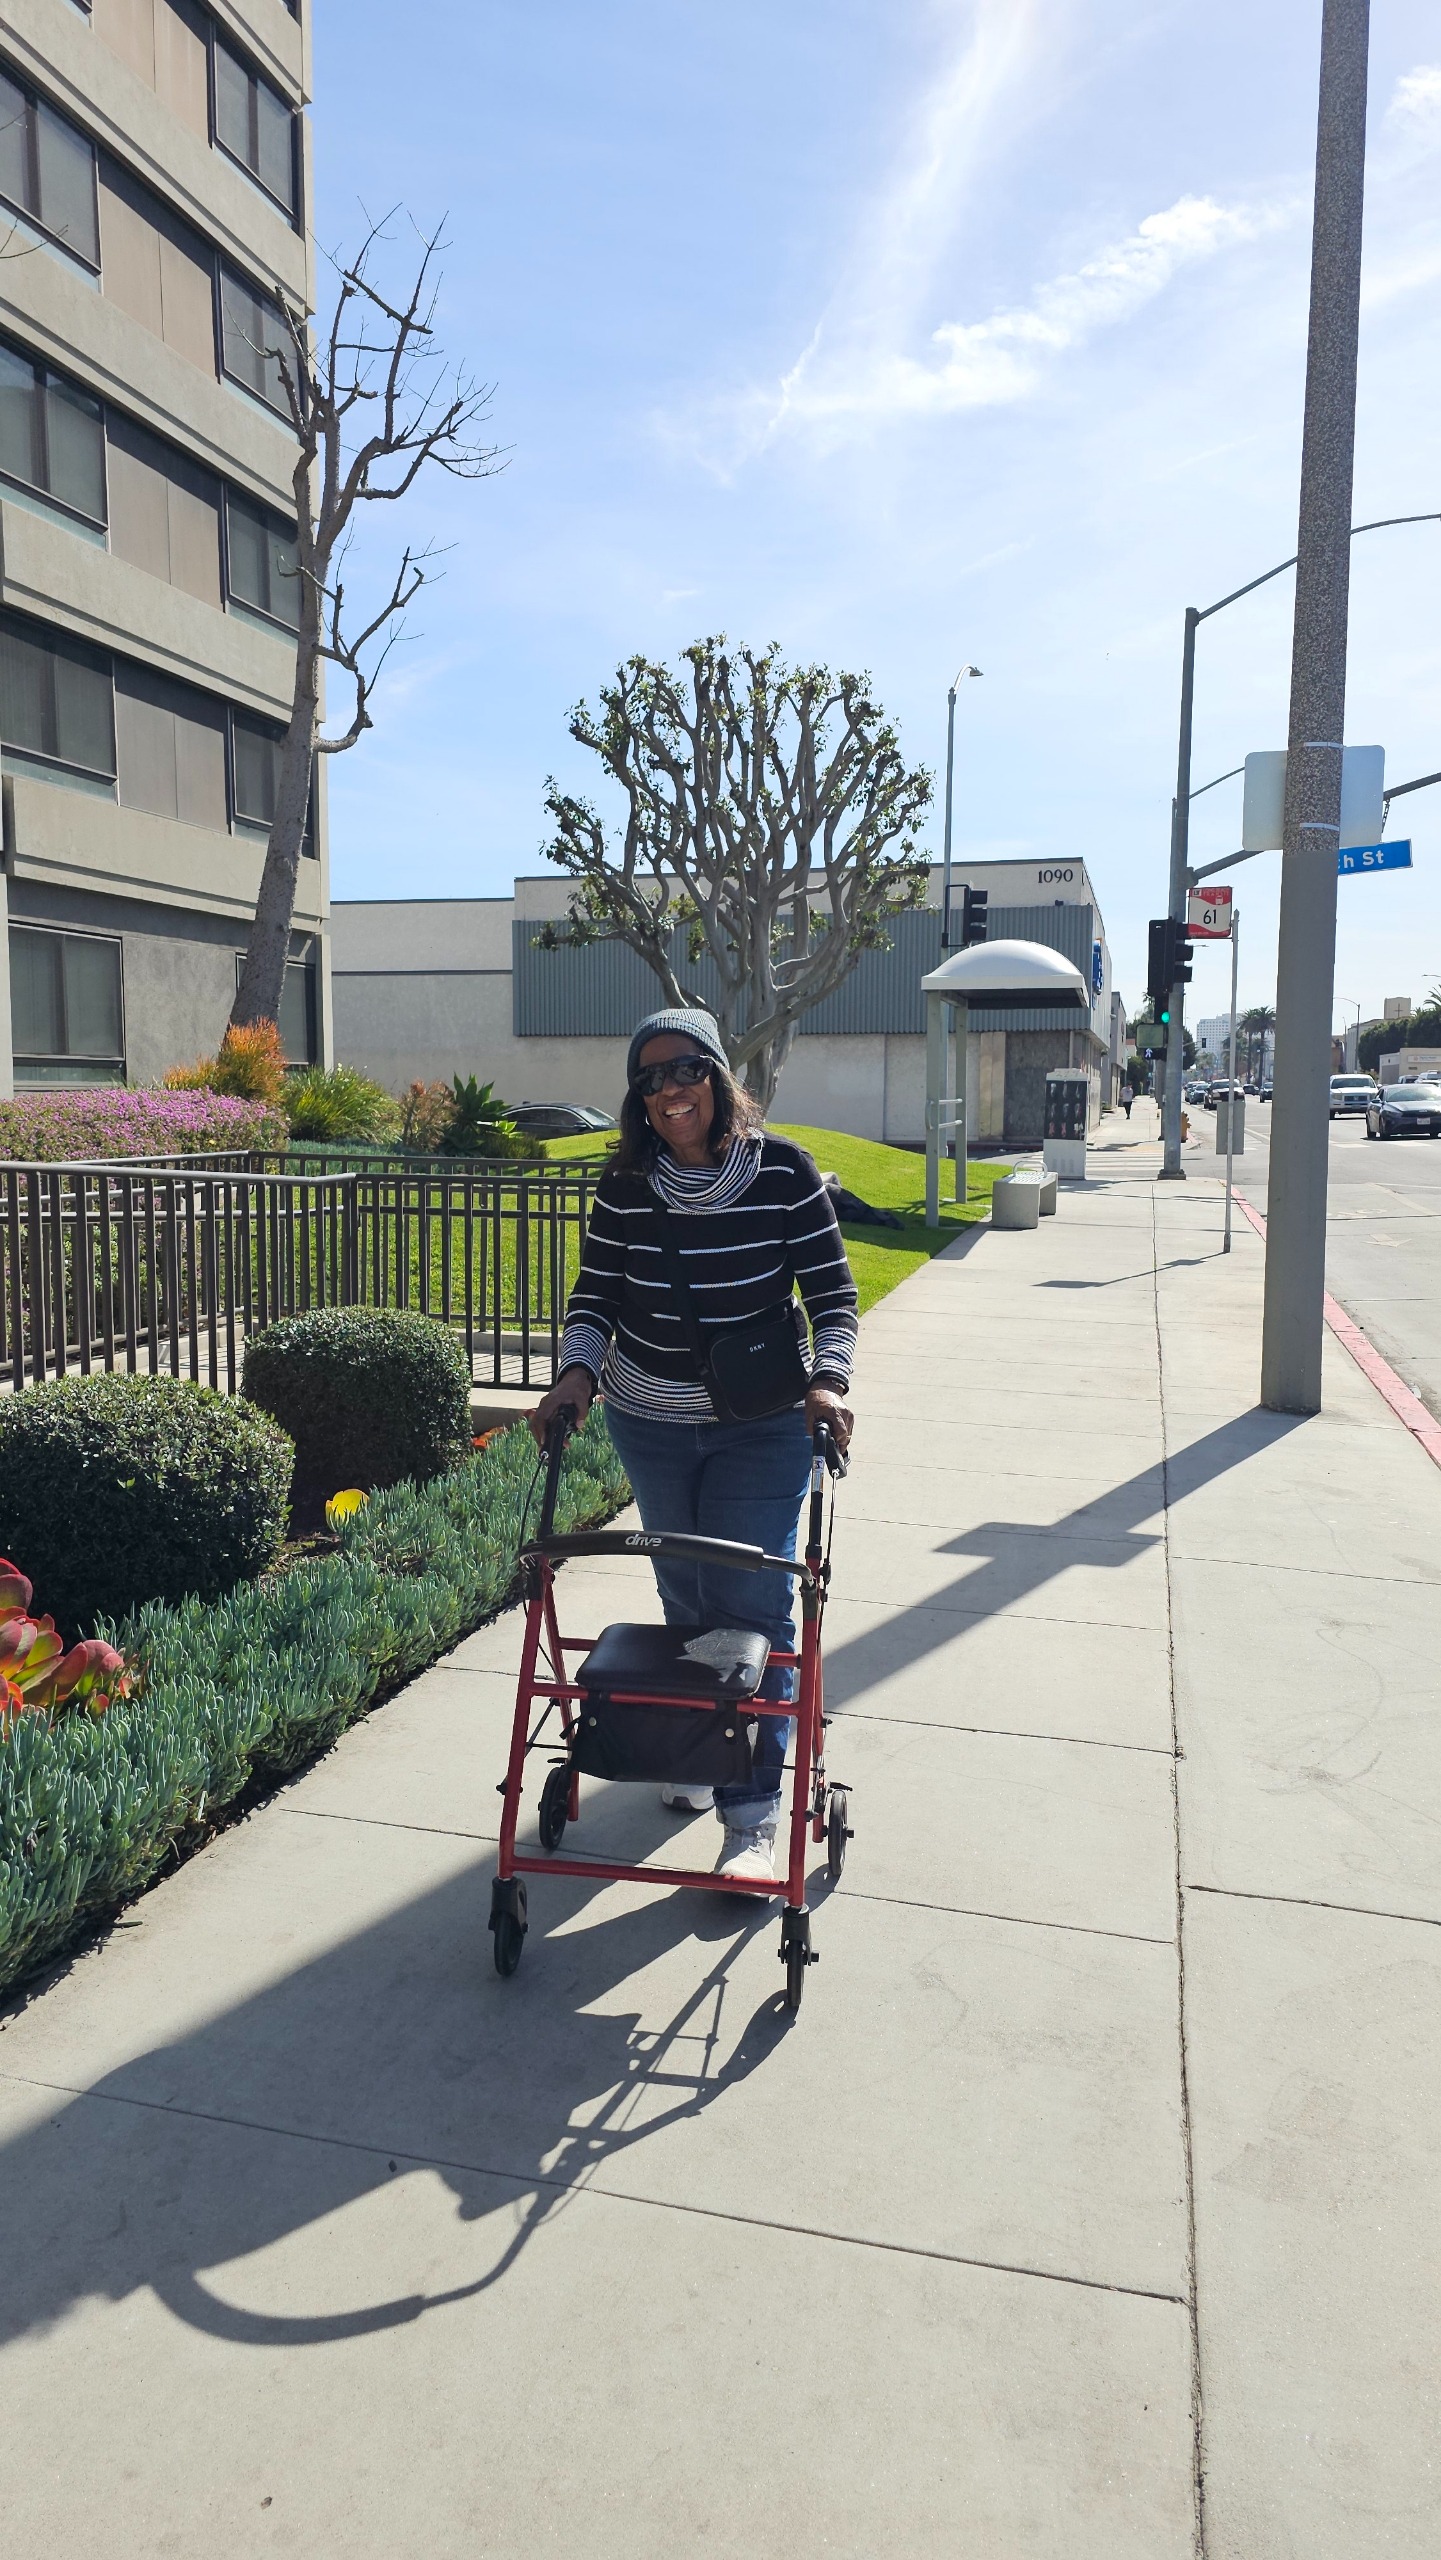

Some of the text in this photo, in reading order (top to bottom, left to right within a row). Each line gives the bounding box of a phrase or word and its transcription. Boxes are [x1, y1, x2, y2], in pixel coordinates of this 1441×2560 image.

[1362, 849, 1384, 866] St
[1038, 868, 1074, 884] 1090
[1203, 909, 1217, 924] 61
[749, 1342, 765, 1353] DKNY
[625, 1533, 663, 1547] drive
